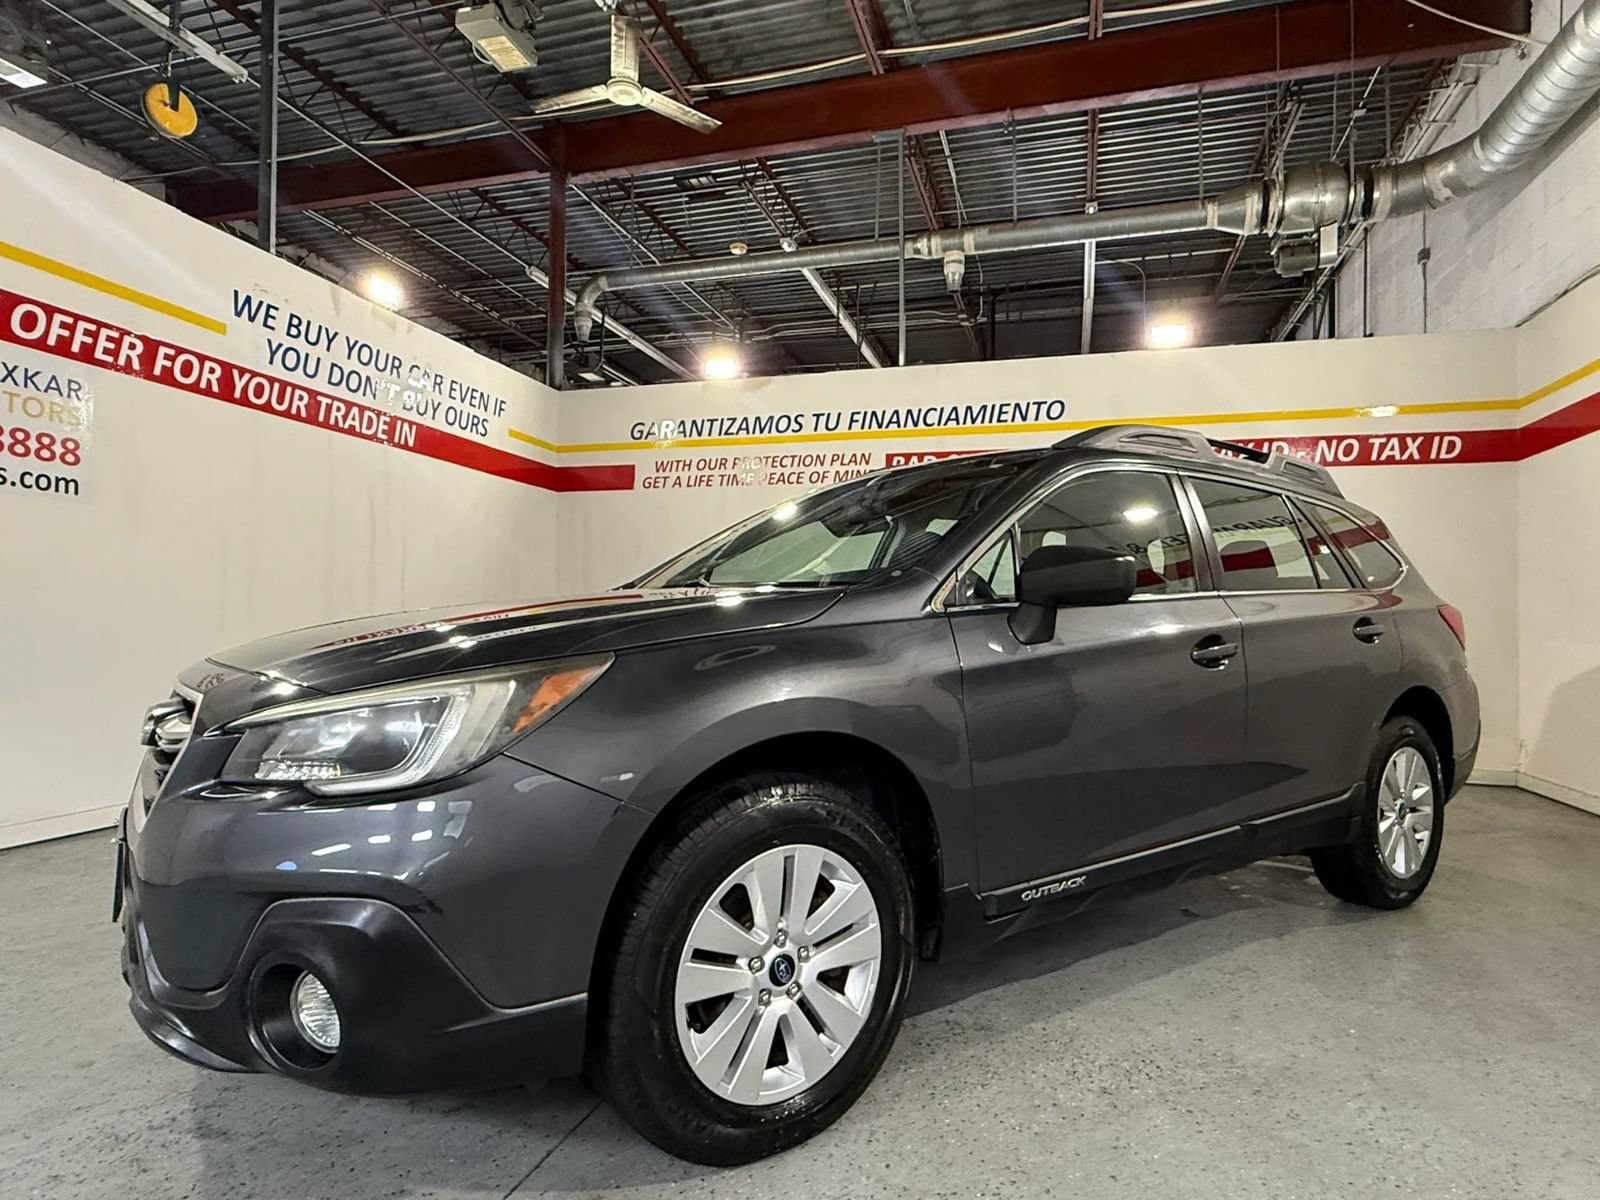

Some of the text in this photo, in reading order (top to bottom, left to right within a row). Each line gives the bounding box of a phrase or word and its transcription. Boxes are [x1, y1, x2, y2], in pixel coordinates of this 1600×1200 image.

[233, 288, 507, 417] WE BUY YOUR CAR EVEN IF
[0, 361, 82, 401] XKAR
[10, 303, 417, 447] OFFER FOR YOUR TRADE IN
[266, 338, 322, 380] YOU
[402, 390, 442, 420] BUY
[445, 406, 489, 437] OURS
[630, 399, 1066, 441] GARANTIZAMOS TU FINANCIAMIENTO
[0, 425, 81, 467] 888
[655, 452, 872, 473] WITH OUR PROTECTION PLAN
[1314, 438, 1361, 463] NO
[1369, 435, 1425, 462] TAX
[1429, 434, 1463, 460] ID
[642, 475, 670, 489] GET
[671, 475, 683, 488] A
[686, 474, 715, 488] LIFE
[758, 471, 805, 485] PEACE
[809, 470, 831, 484] OF
[1021, 875, 1087, 902] OUTBACK
